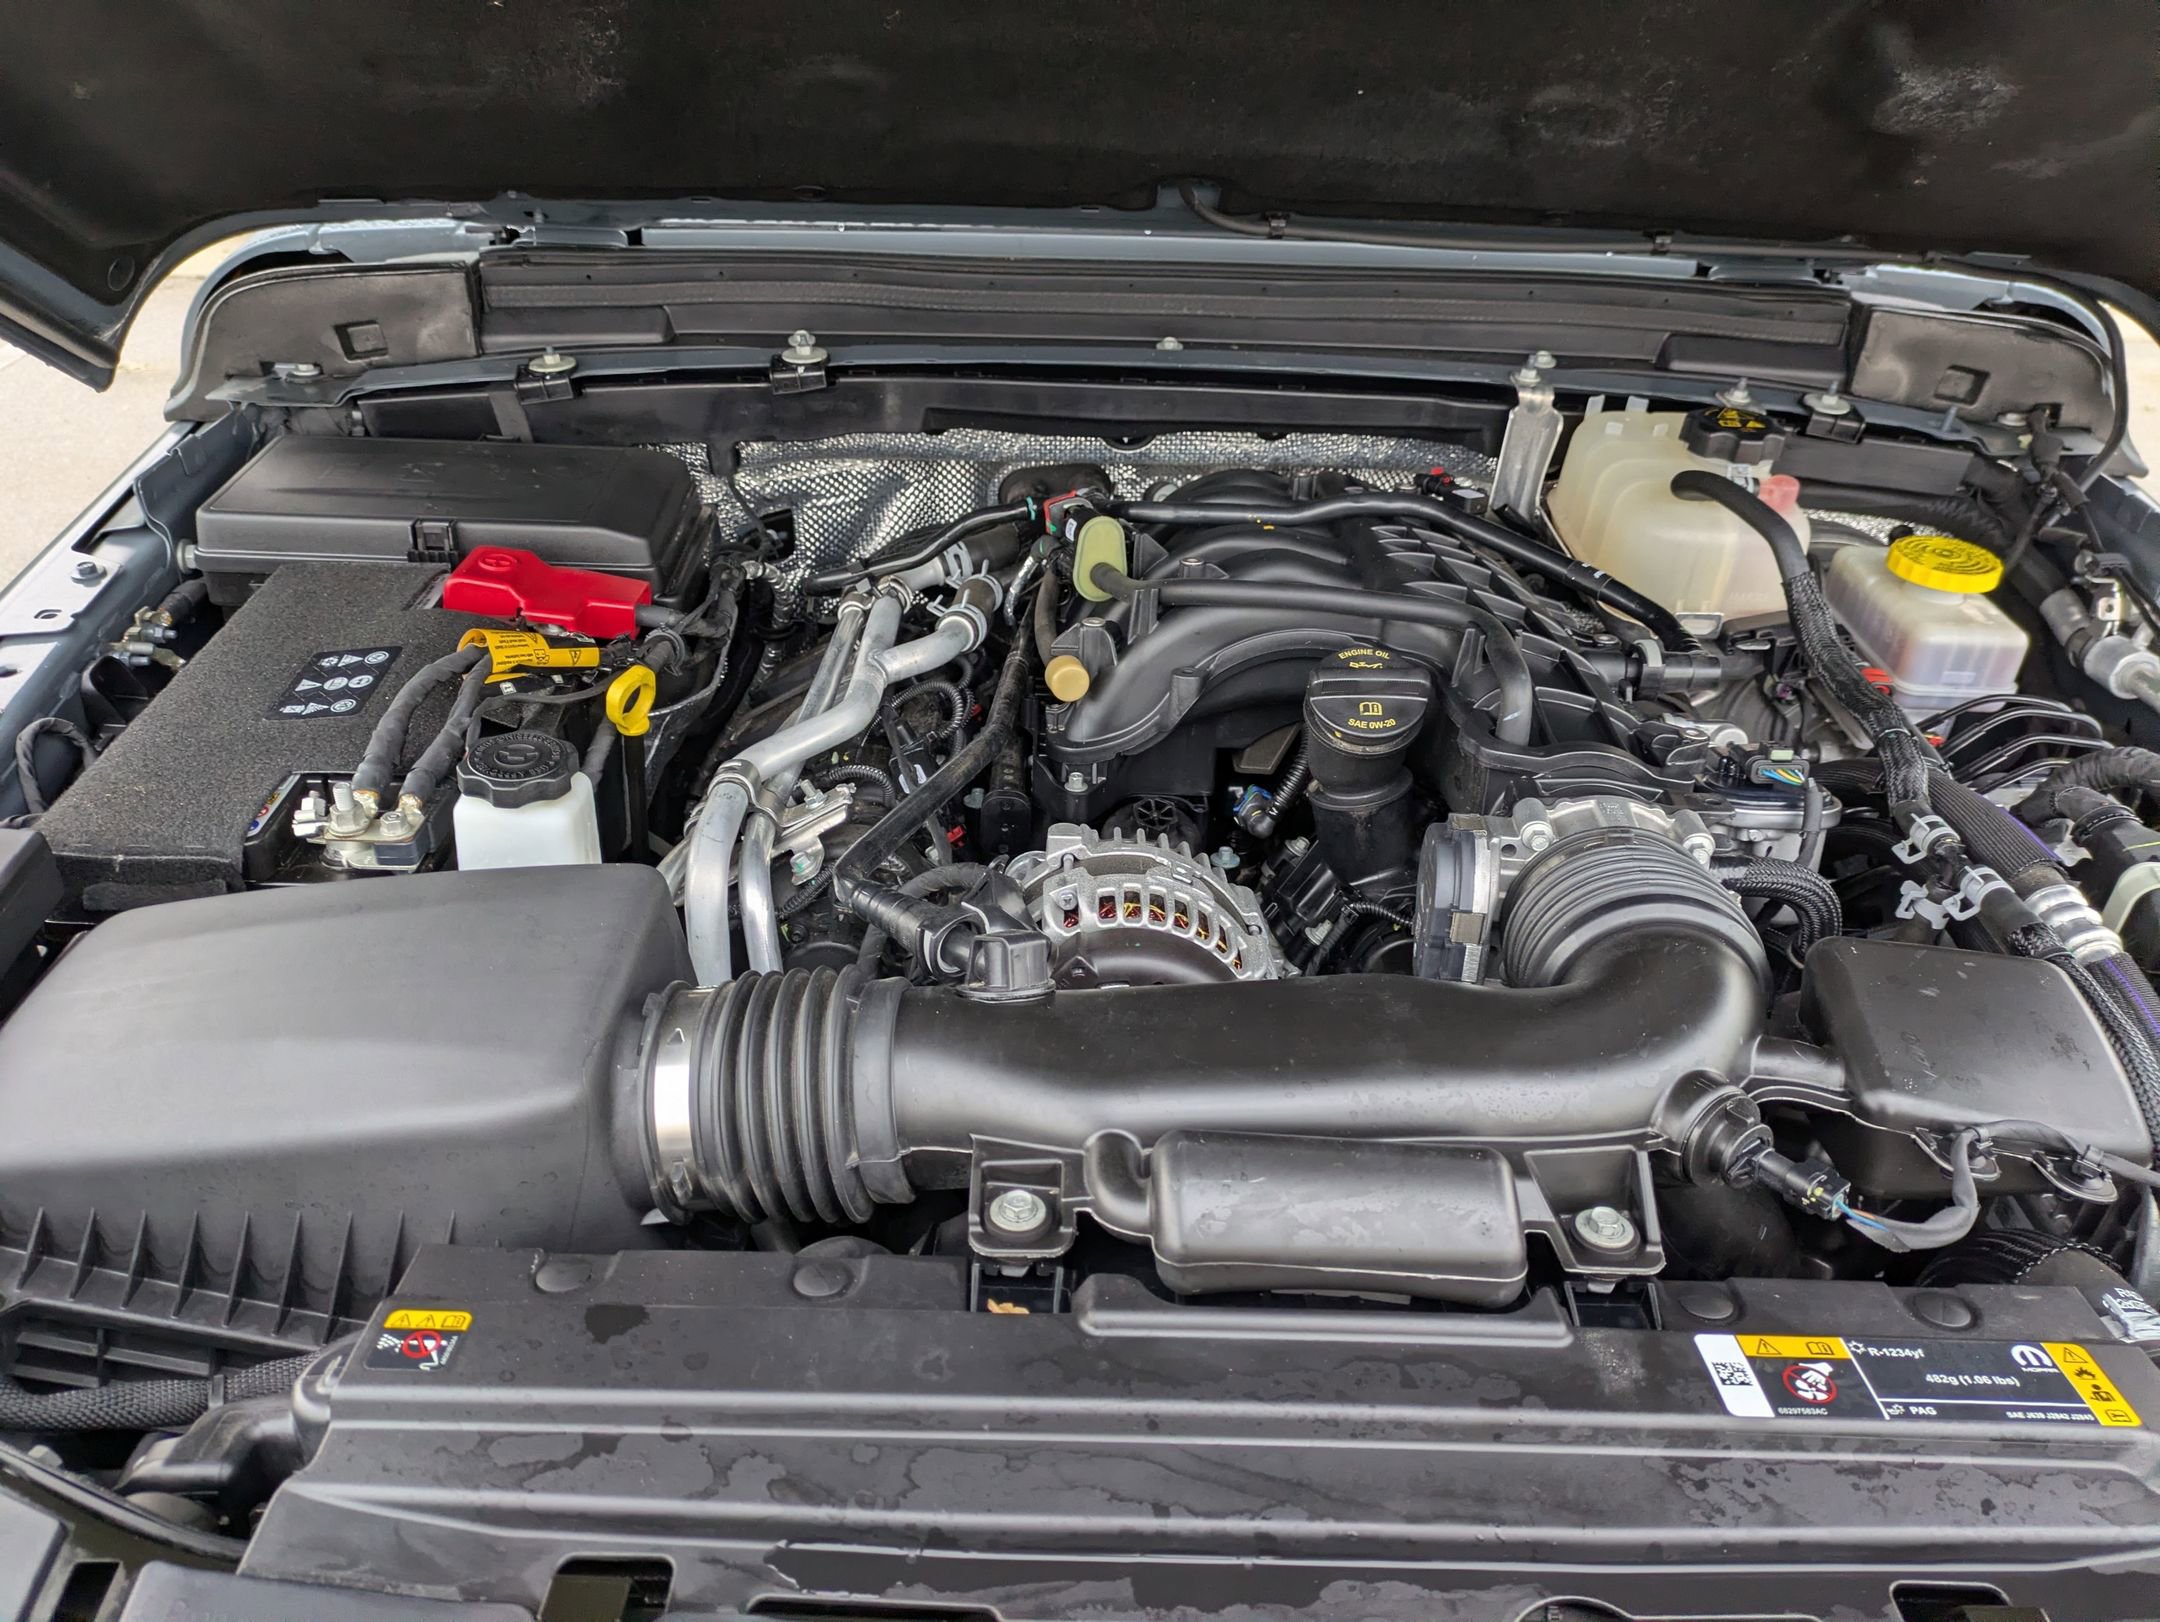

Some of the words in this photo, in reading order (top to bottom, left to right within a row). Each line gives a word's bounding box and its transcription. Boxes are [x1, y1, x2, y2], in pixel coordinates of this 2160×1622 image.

[1338, 649, 1373, 659] ENGINE
[1375, 650, 1390, 659] OIL
[1348, 718, 1367, 729] SAE
[1369, 718, 1397, 729] 0W-20
[1867, 1347, 1925, 1359] R-1234yf
[1925, 1374, 1959, 1386] 482g
[1961, 1374, 1991, 1386] (1.06
[1994, 1375, 2021, 1387] lbs)
[1909, 1406, 1937, 1416] PAG
